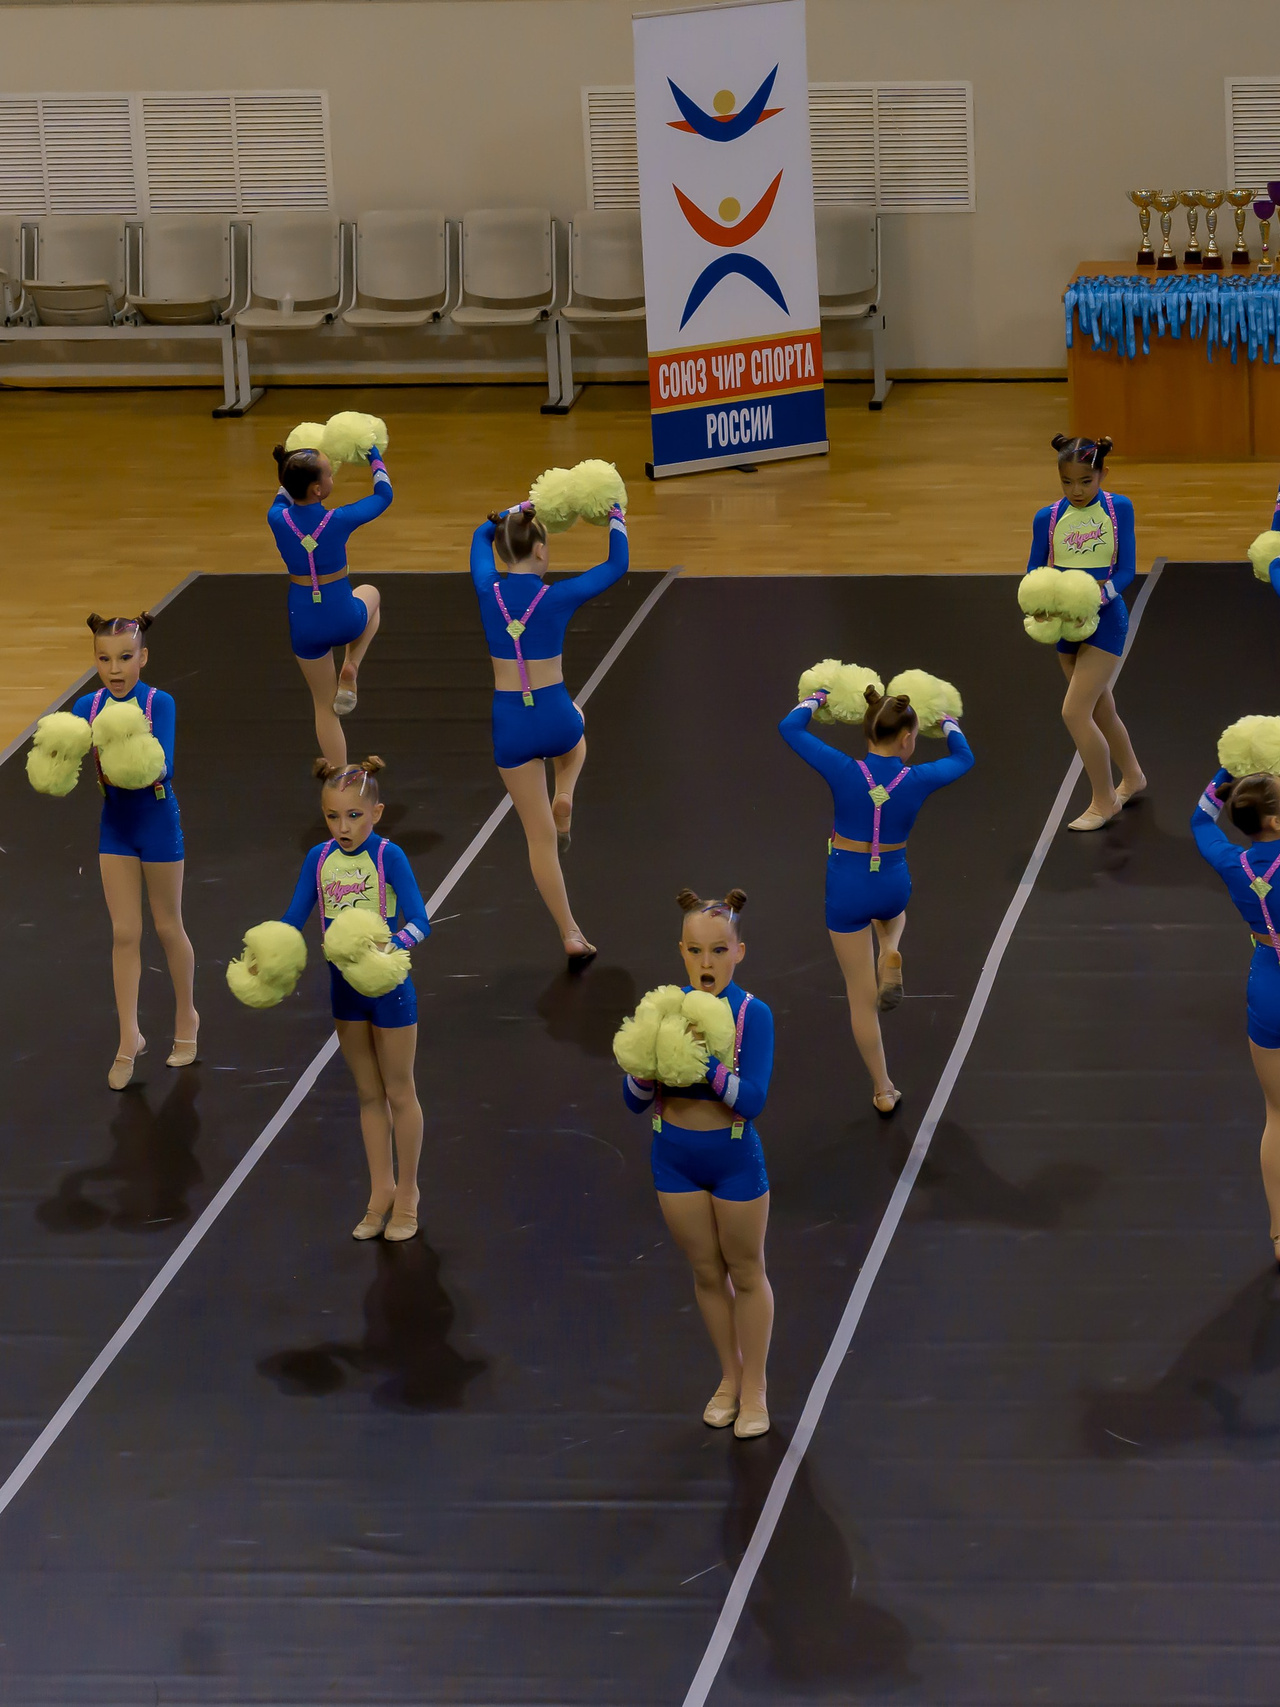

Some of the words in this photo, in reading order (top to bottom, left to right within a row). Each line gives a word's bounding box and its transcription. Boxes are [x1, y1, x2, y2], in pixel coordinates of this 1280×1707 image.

[658, 358, 708, 400] СОЮЗ
[711, 352, 746, 391] ЧИР
[751, 342, 815, 386] СПОРТА
[706, 404, 773, 449] РОССИИ
